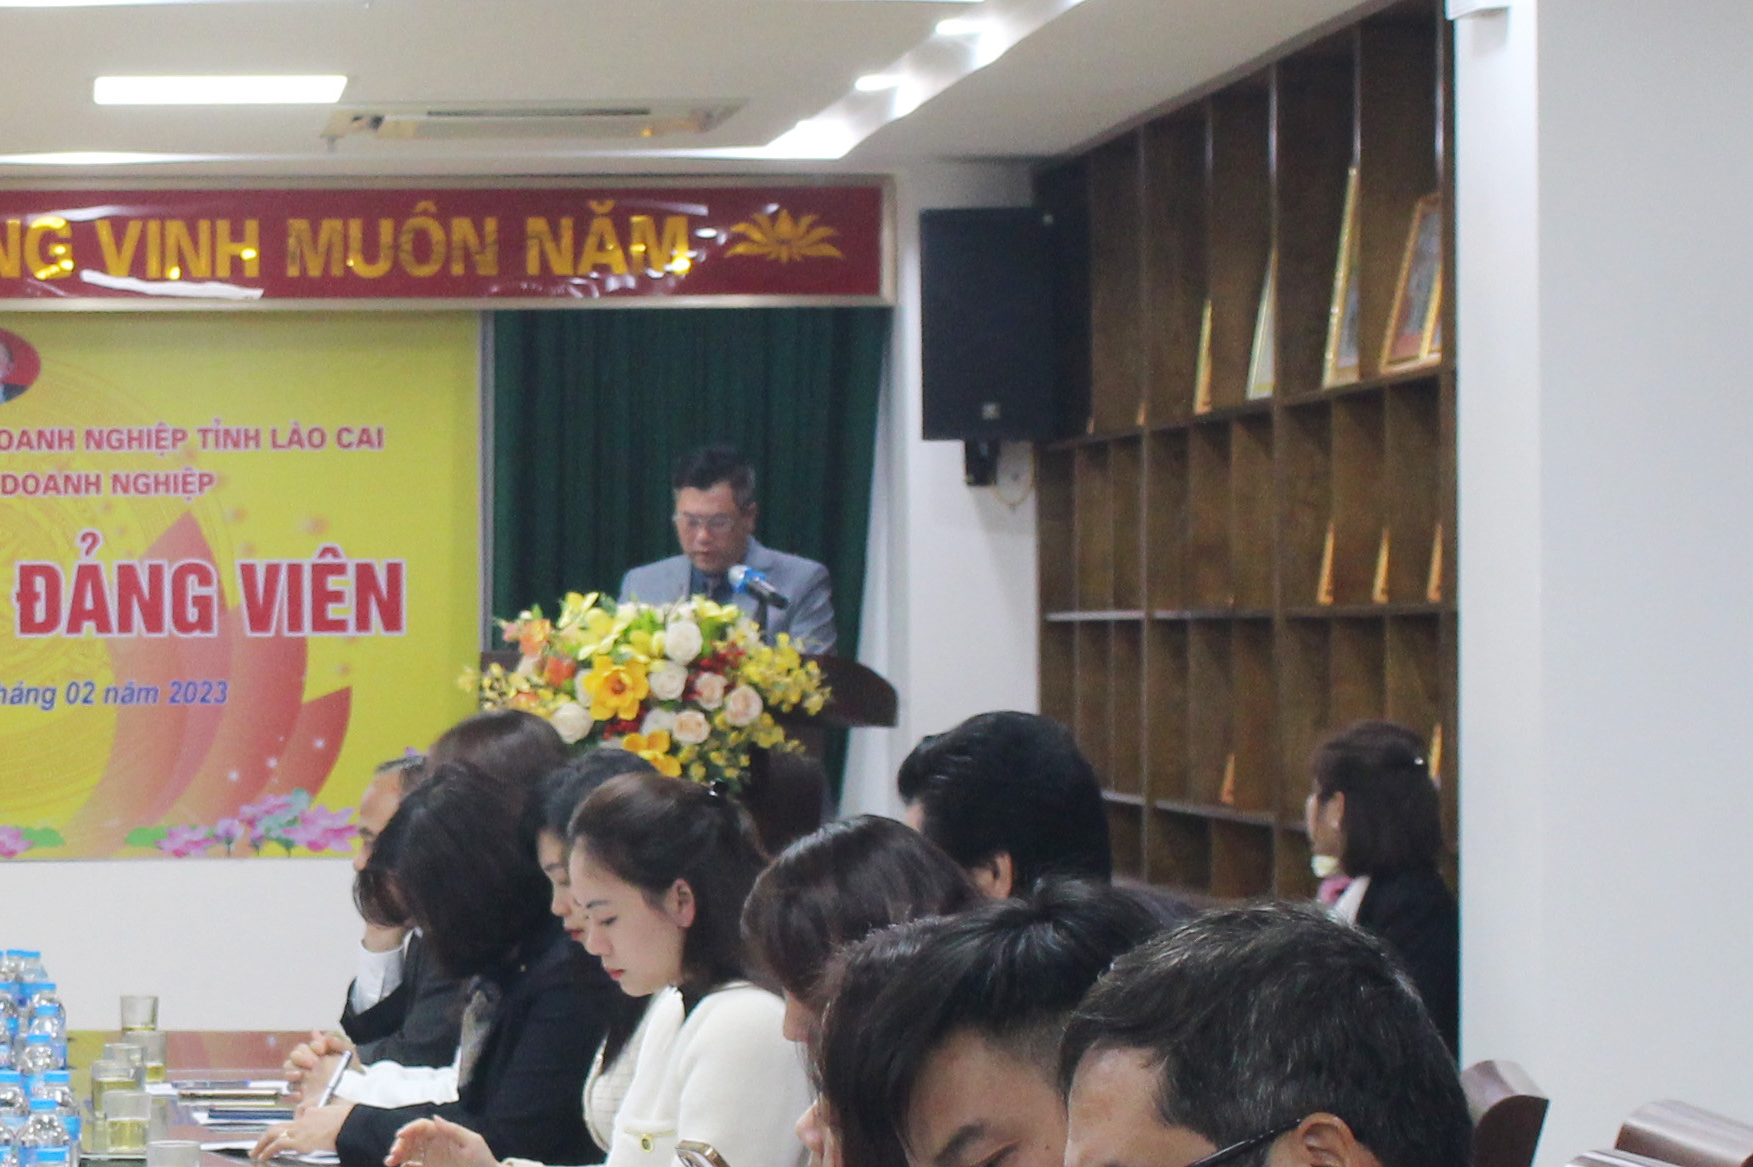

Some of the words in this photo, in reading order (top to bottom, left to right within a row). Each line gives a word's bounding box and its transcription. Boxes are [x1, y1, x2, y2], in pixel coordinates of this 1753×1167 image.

[94, 219, 260, 279] VINH
[287, 200, 497, 278] MUÔN
[526, 200, 690, 277] NĂM
[85, 420, 188, 456] NGHIỆP
[197, 417, 261, 450] TỈNH
[336, 426, 384, 449] CAI
[1, 472, 102, 497] DOANH
[111, 466, 216, 502] NGHIỆP
[14, 530, 218, 639] ĐẢNG
[238, 545, 406, 638] VIÊN
[65, 680, 96, 704] 02
[169, 679, 228, 704] 2023
